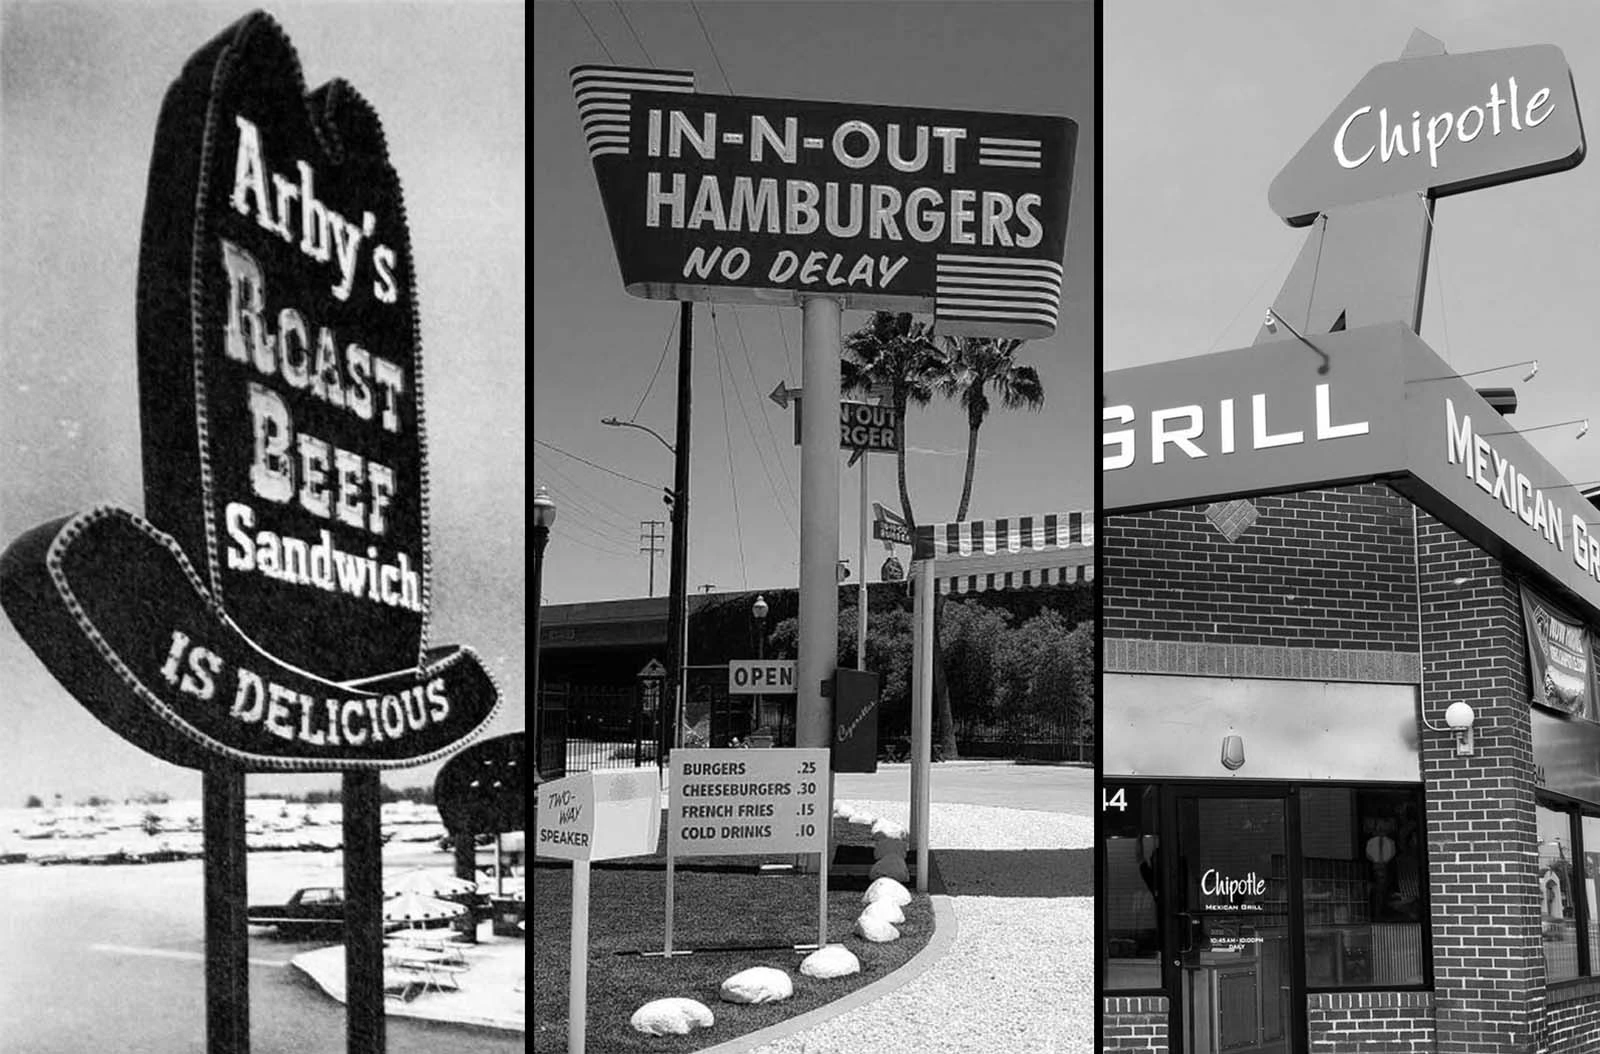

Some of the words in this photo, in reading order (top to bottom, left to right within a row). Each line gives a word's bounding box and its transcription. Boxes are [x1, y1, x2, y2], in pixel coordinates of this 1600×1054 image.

[646, 108, 968, 175] IN-N-OUT
[1333, 77, 1556, 169] Chipotle
[230, 114, 398, 304] Arby's
[645, 171, 1044, 249] HAMBURGERS
[682, 246, 752, 281] NO
[767, 249, 909, 288] DELAY
[221, 238, 403, 434] ROAST
[248, 381, 396, 534] BEEF
[1446, 398, 1564, 552] MEXICAN
[225, 502, 423, 612] Sandwich
[160, 631, 223, 701] IS
[230, 667, 450, 746] DELICIOUS
[734, 666, 793, 687] OPEN
[682, 782, 791, 797] CHEESEBURGERS
[796, 781, 816, 795] .30
[683, 762, 746, 776] BURGERS
[797, 761, 817, 774] .25
[548, 789, 577, 809] TWO-
[559, 804, 582, 825] WAY
[682, 804, 733, 818] FRENCH
[738, 803, 774, 817] FRIES
[796, 803, 815, 816] .15
[540, 828, 589, 847] SPEAKER
[681, 826, 716, 840] COLD
[721, 824, 772, 839] DRINKS
[795, 823, 816, 837] .10
[1201, 868, 1266, 903] Chipotle
